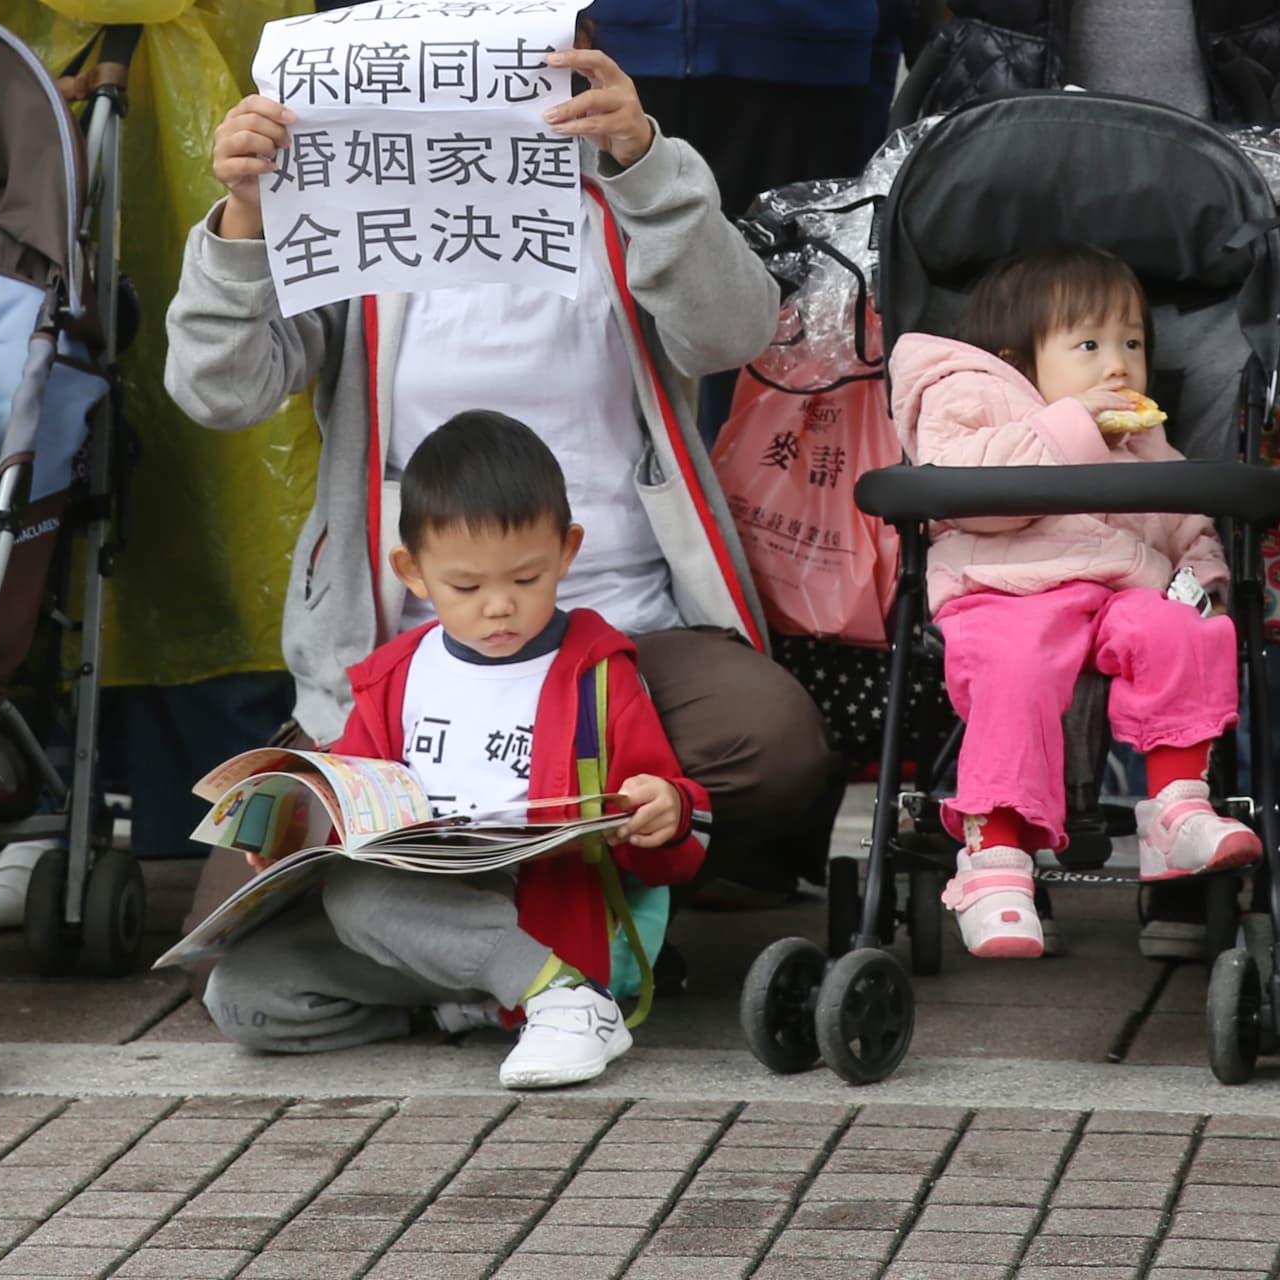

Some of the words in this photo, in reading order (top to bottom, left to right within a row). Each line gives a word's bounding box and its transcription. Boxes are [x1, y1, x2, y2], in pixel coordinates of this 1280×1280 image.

[271, 37, 556, 105] 保障同志
[269, 129, 578, 194] 婚姻家庭
[274, 204, 578, 287] 全民決定
